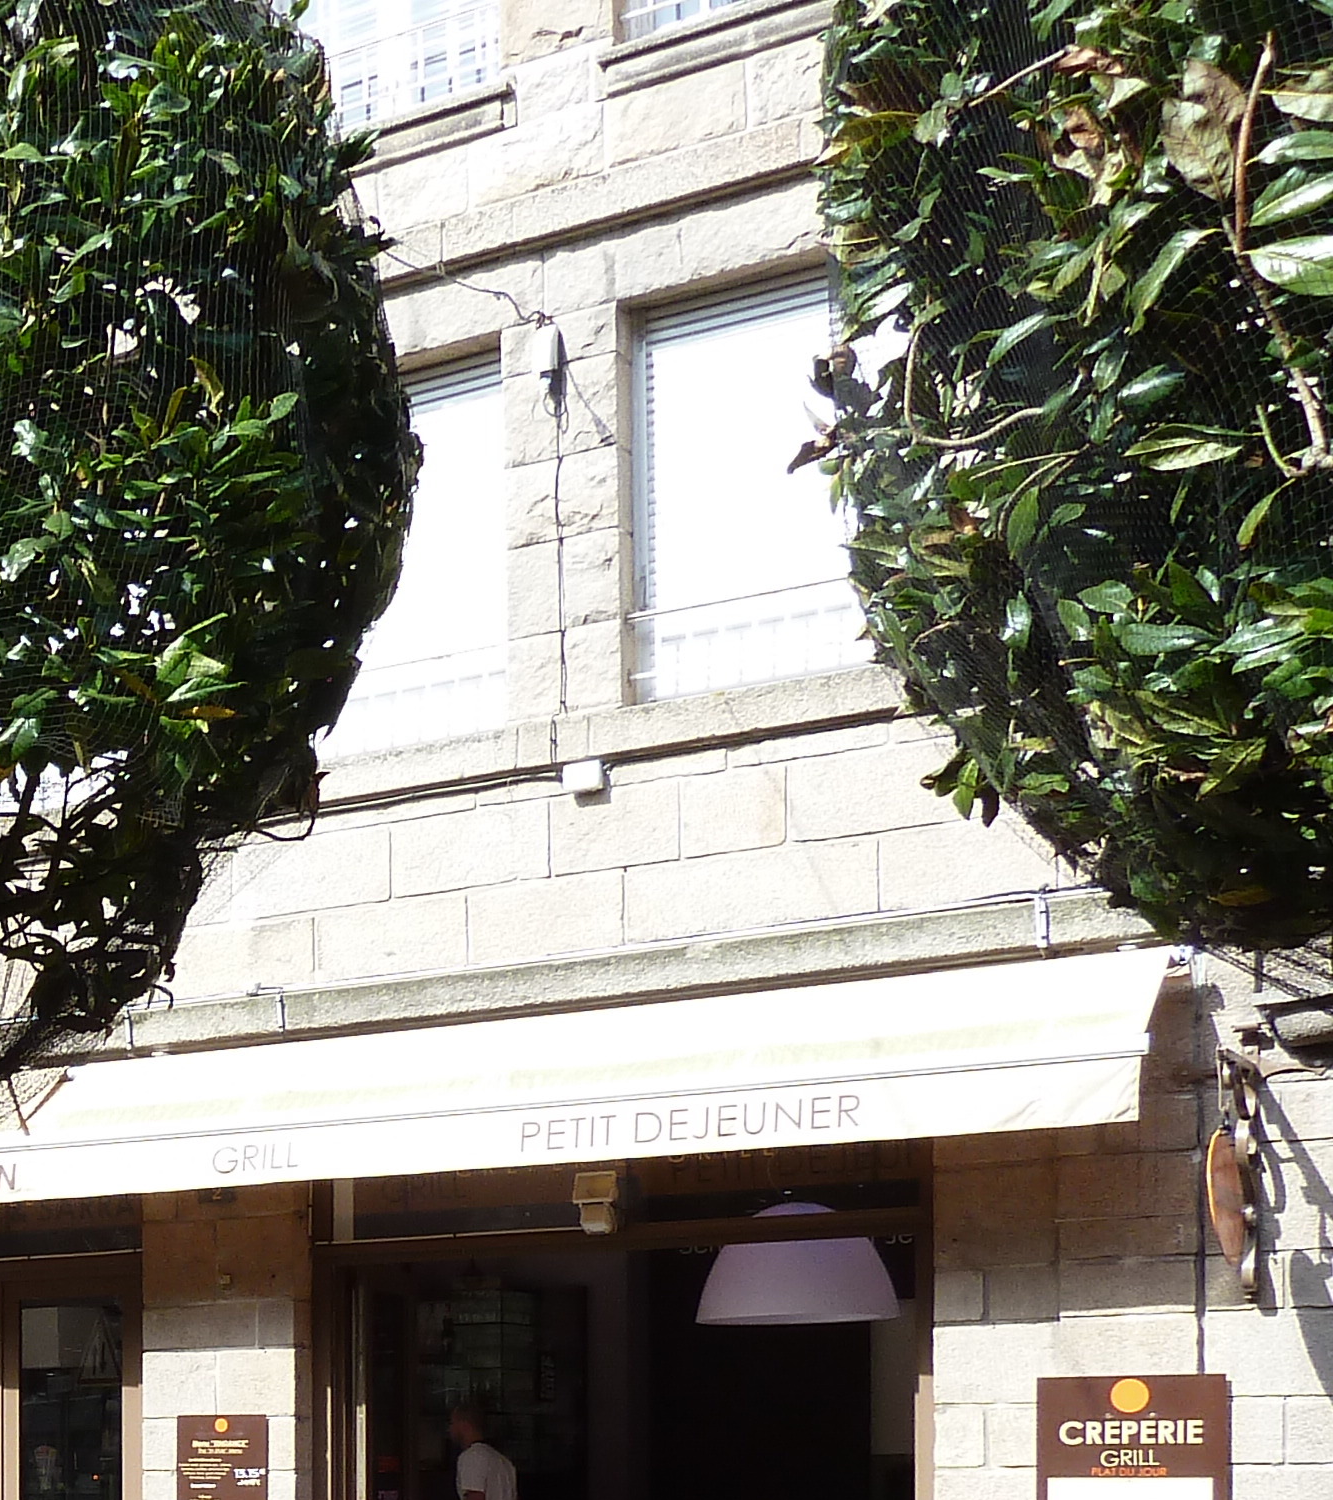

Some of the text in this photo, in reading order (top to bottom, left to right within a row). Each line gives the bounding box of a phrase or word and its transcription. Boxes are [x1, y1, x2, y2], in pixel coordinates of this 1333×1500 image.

[521, 1095, 860, 1152] PETIT DEJEUNER
[213, 1141, 299, 1174] GRILL
[1099, 1449, 1161, 1467] GRILL
[1090, 1467, 1168, 1477] PLAT DU JOUR
